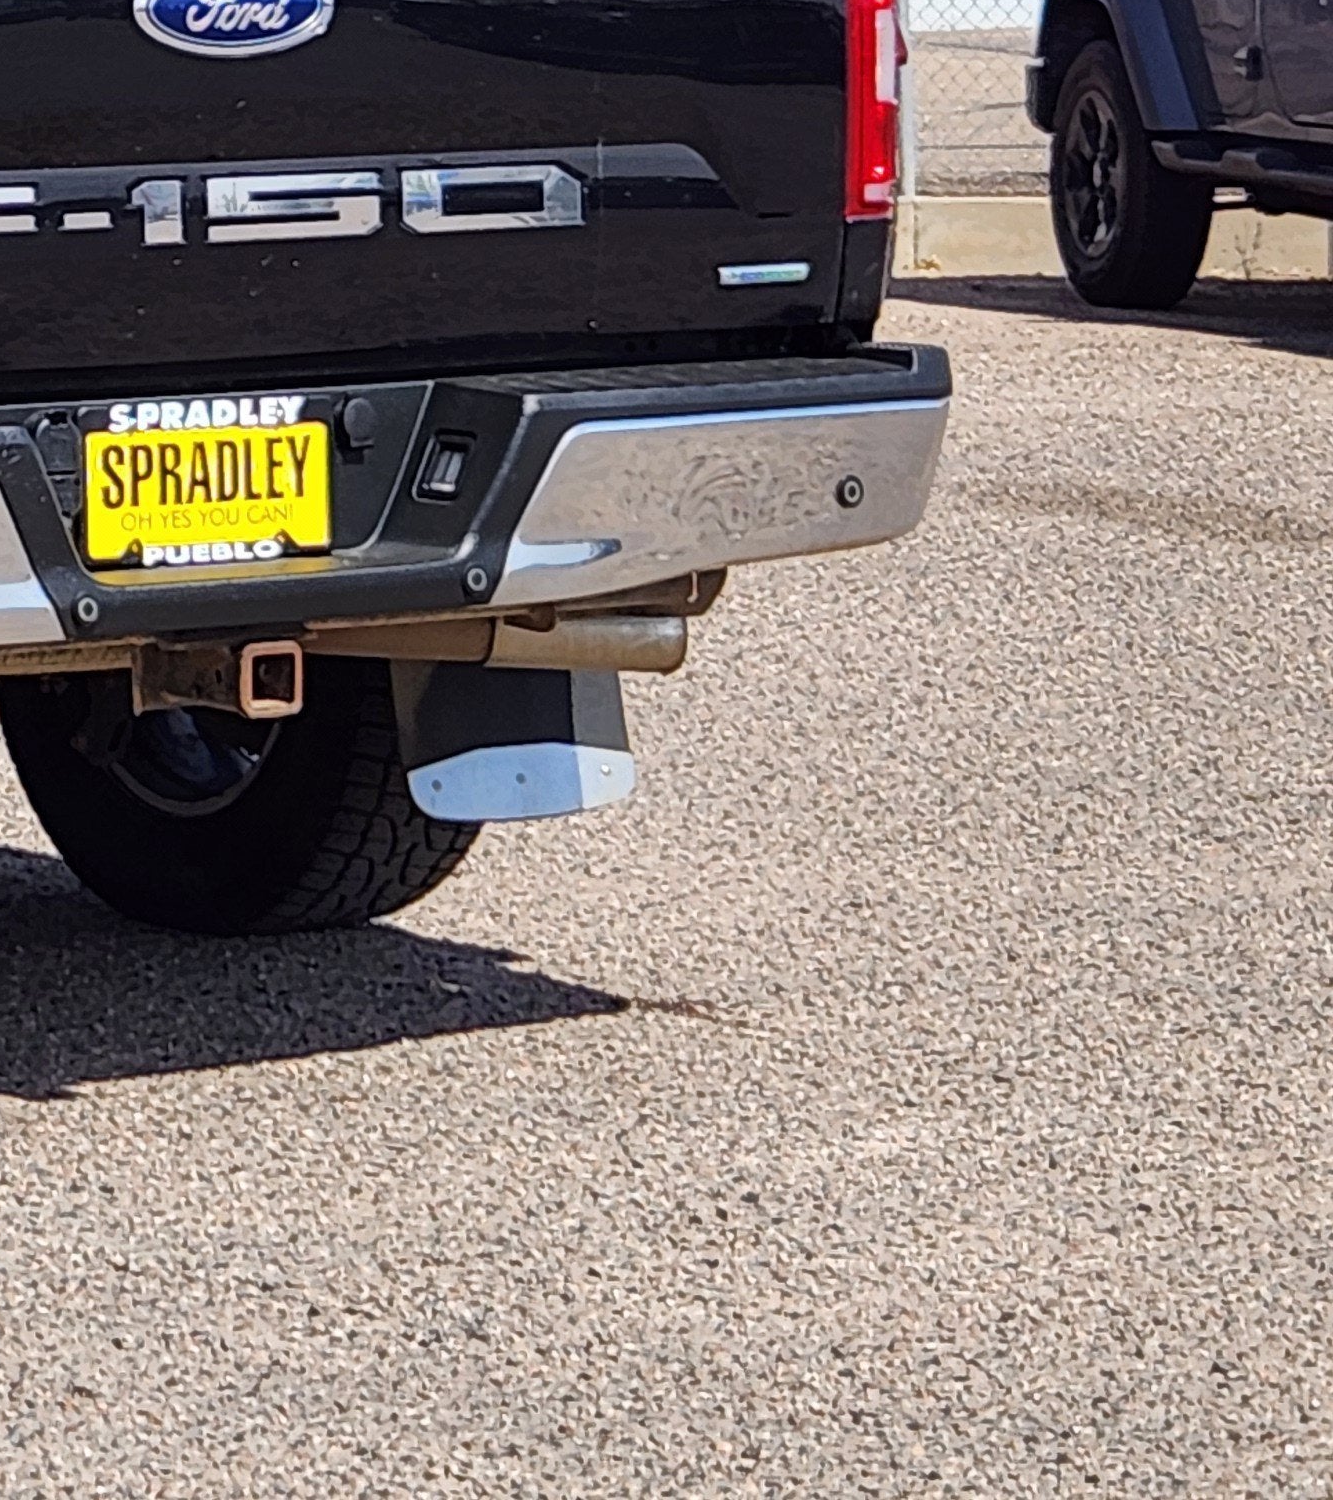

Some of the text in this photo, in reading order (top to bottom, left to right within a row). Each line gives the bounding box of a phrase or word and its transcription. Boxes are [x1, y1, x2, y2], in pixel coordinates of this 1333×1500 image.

[108, 396, 306, 433] SPRADLEY
[100, 434, 311, 510] SPRADLEY
[120, 503, 294, 532] OH YES YOU CAN!
[142, 538, 284, 567] PUEBLO
